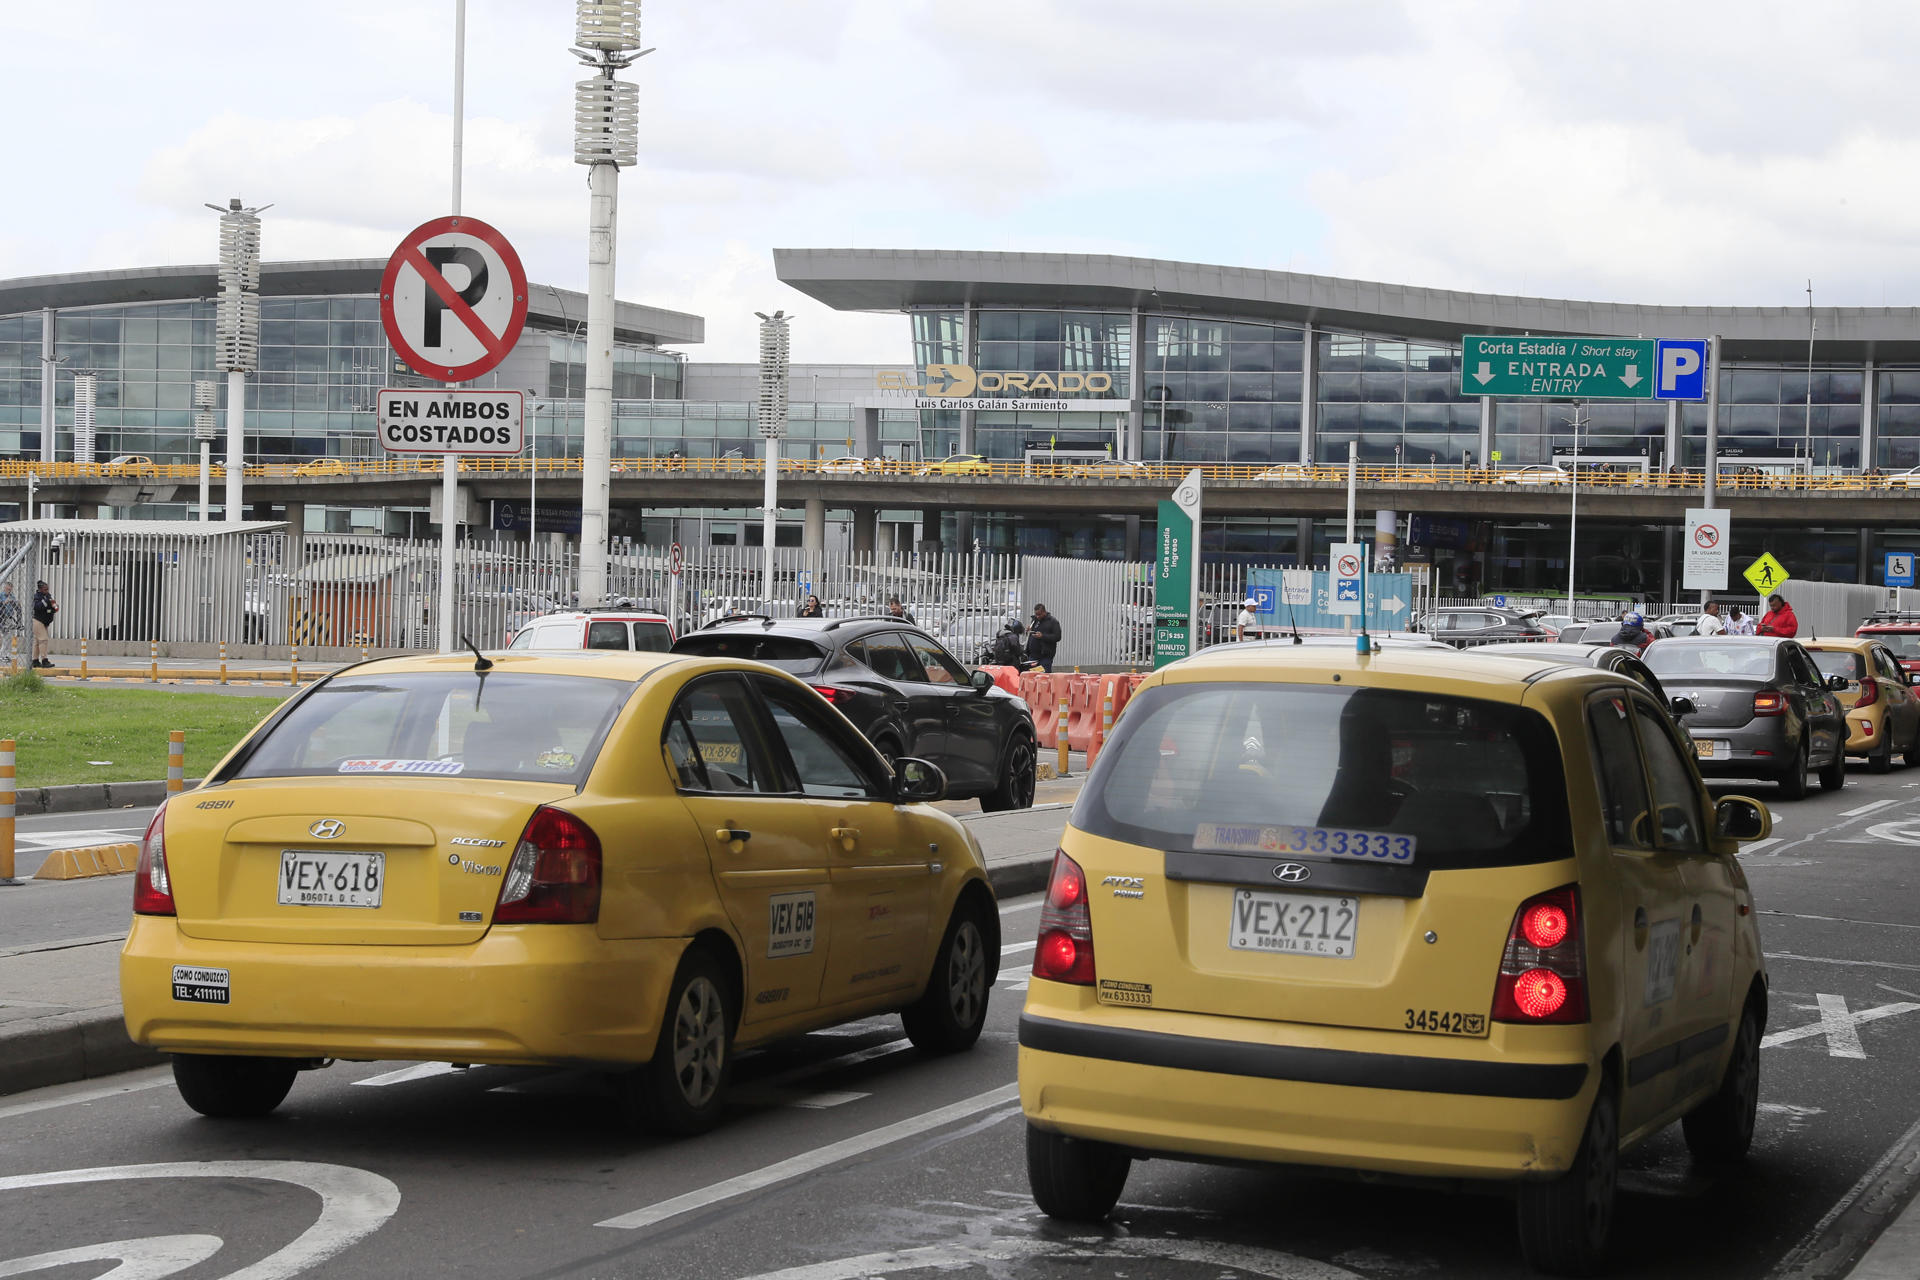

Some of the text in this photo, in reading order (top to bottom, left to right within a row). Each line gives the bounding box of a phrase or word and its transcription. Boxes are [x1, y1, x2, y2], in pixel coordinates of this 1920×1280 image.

[424, 246, 489, 347] P
[1478, 341, 1514, 355] Corta
[1519, 341, 1566, 356] Estadía
[1580, 345, 1611, 357] Short
[1615, 347, 1638, 360] stay
[1508, 362, 1607, 377] ENTRADA
[1661, 347, 1700, 391] P
[1531, 378, 1583, 393] ENTRY
[389, 400, 510, 419] EN AMBOS
[914, 398, 1068, 410] Luis Carlos Galán Sarmiento
[387, 424, 511, 444] COSTADOS
[1171, 538, 1179, 568] Ingreso
[1162, 556, 1170, 578] Corta
[1258, 593, 1268, 606] P
[1288, 593, 1305, 601] Entry
[1157, 643, 1186, 651] MINUTO
[195, 800, 235, 809] 48811
[450, 837, 507, 848] ACCENT
[1101, 875, 1144, 889] ATOS
[301, 893, 334, 903] BOGOTA
[1113, 889, 1144, 900] PRIME
[771, 901, 814, 935] VEX 618
[1257, 936, 1297, 950] BOGOTA
[174, 969, 227, 983] ¿COMO CONDUZCO?
[176, 986, 226, 1001] TEL: 4111111
[1405, 1008, 1462, 1033] 34542
